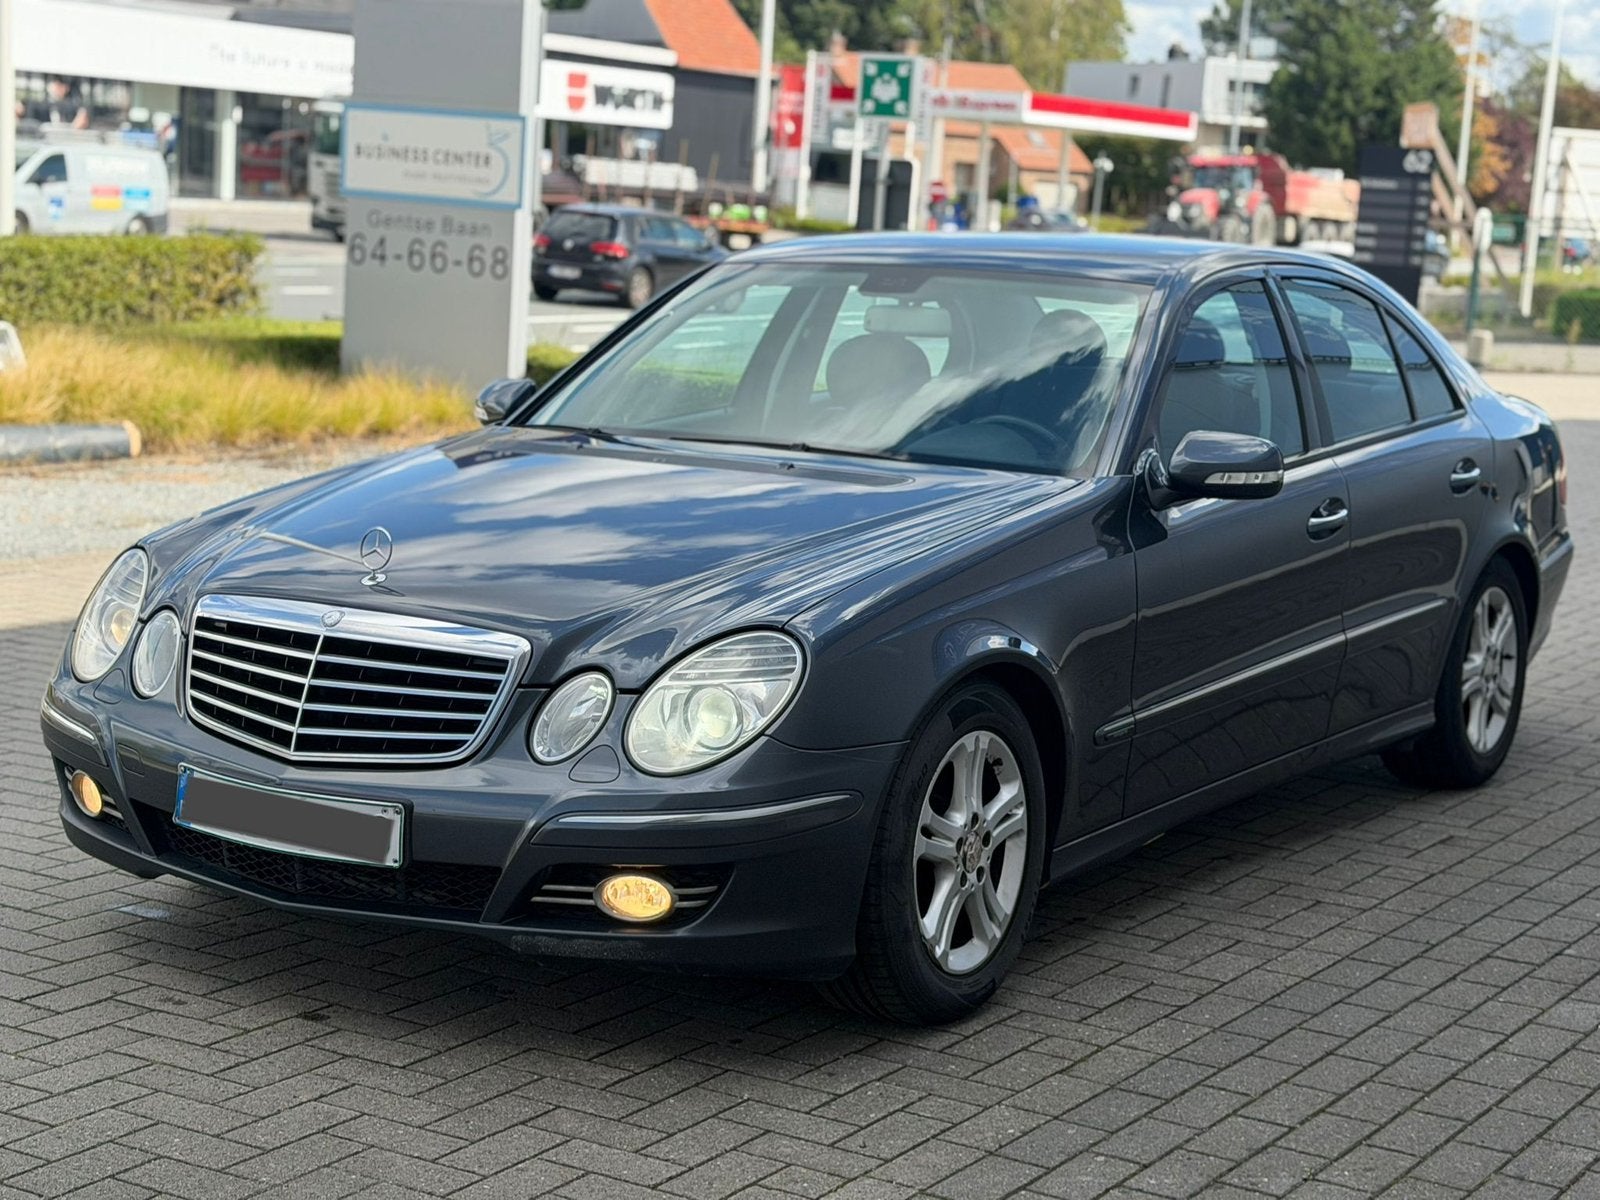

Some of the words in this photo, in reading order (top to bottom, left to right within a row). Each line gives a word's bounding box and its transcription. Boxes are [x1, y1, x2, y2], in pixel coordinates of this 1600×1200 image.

[355, 141, 429, 164] BUSINESS
[431, 147, 491, 168] CENTER
[1402, 149, 1434, 174] 62
[365, 207, 435, 234] Gentse
[440, 213, 492, 239] Baan
[348, 231, 510, 281] 64-66-68
